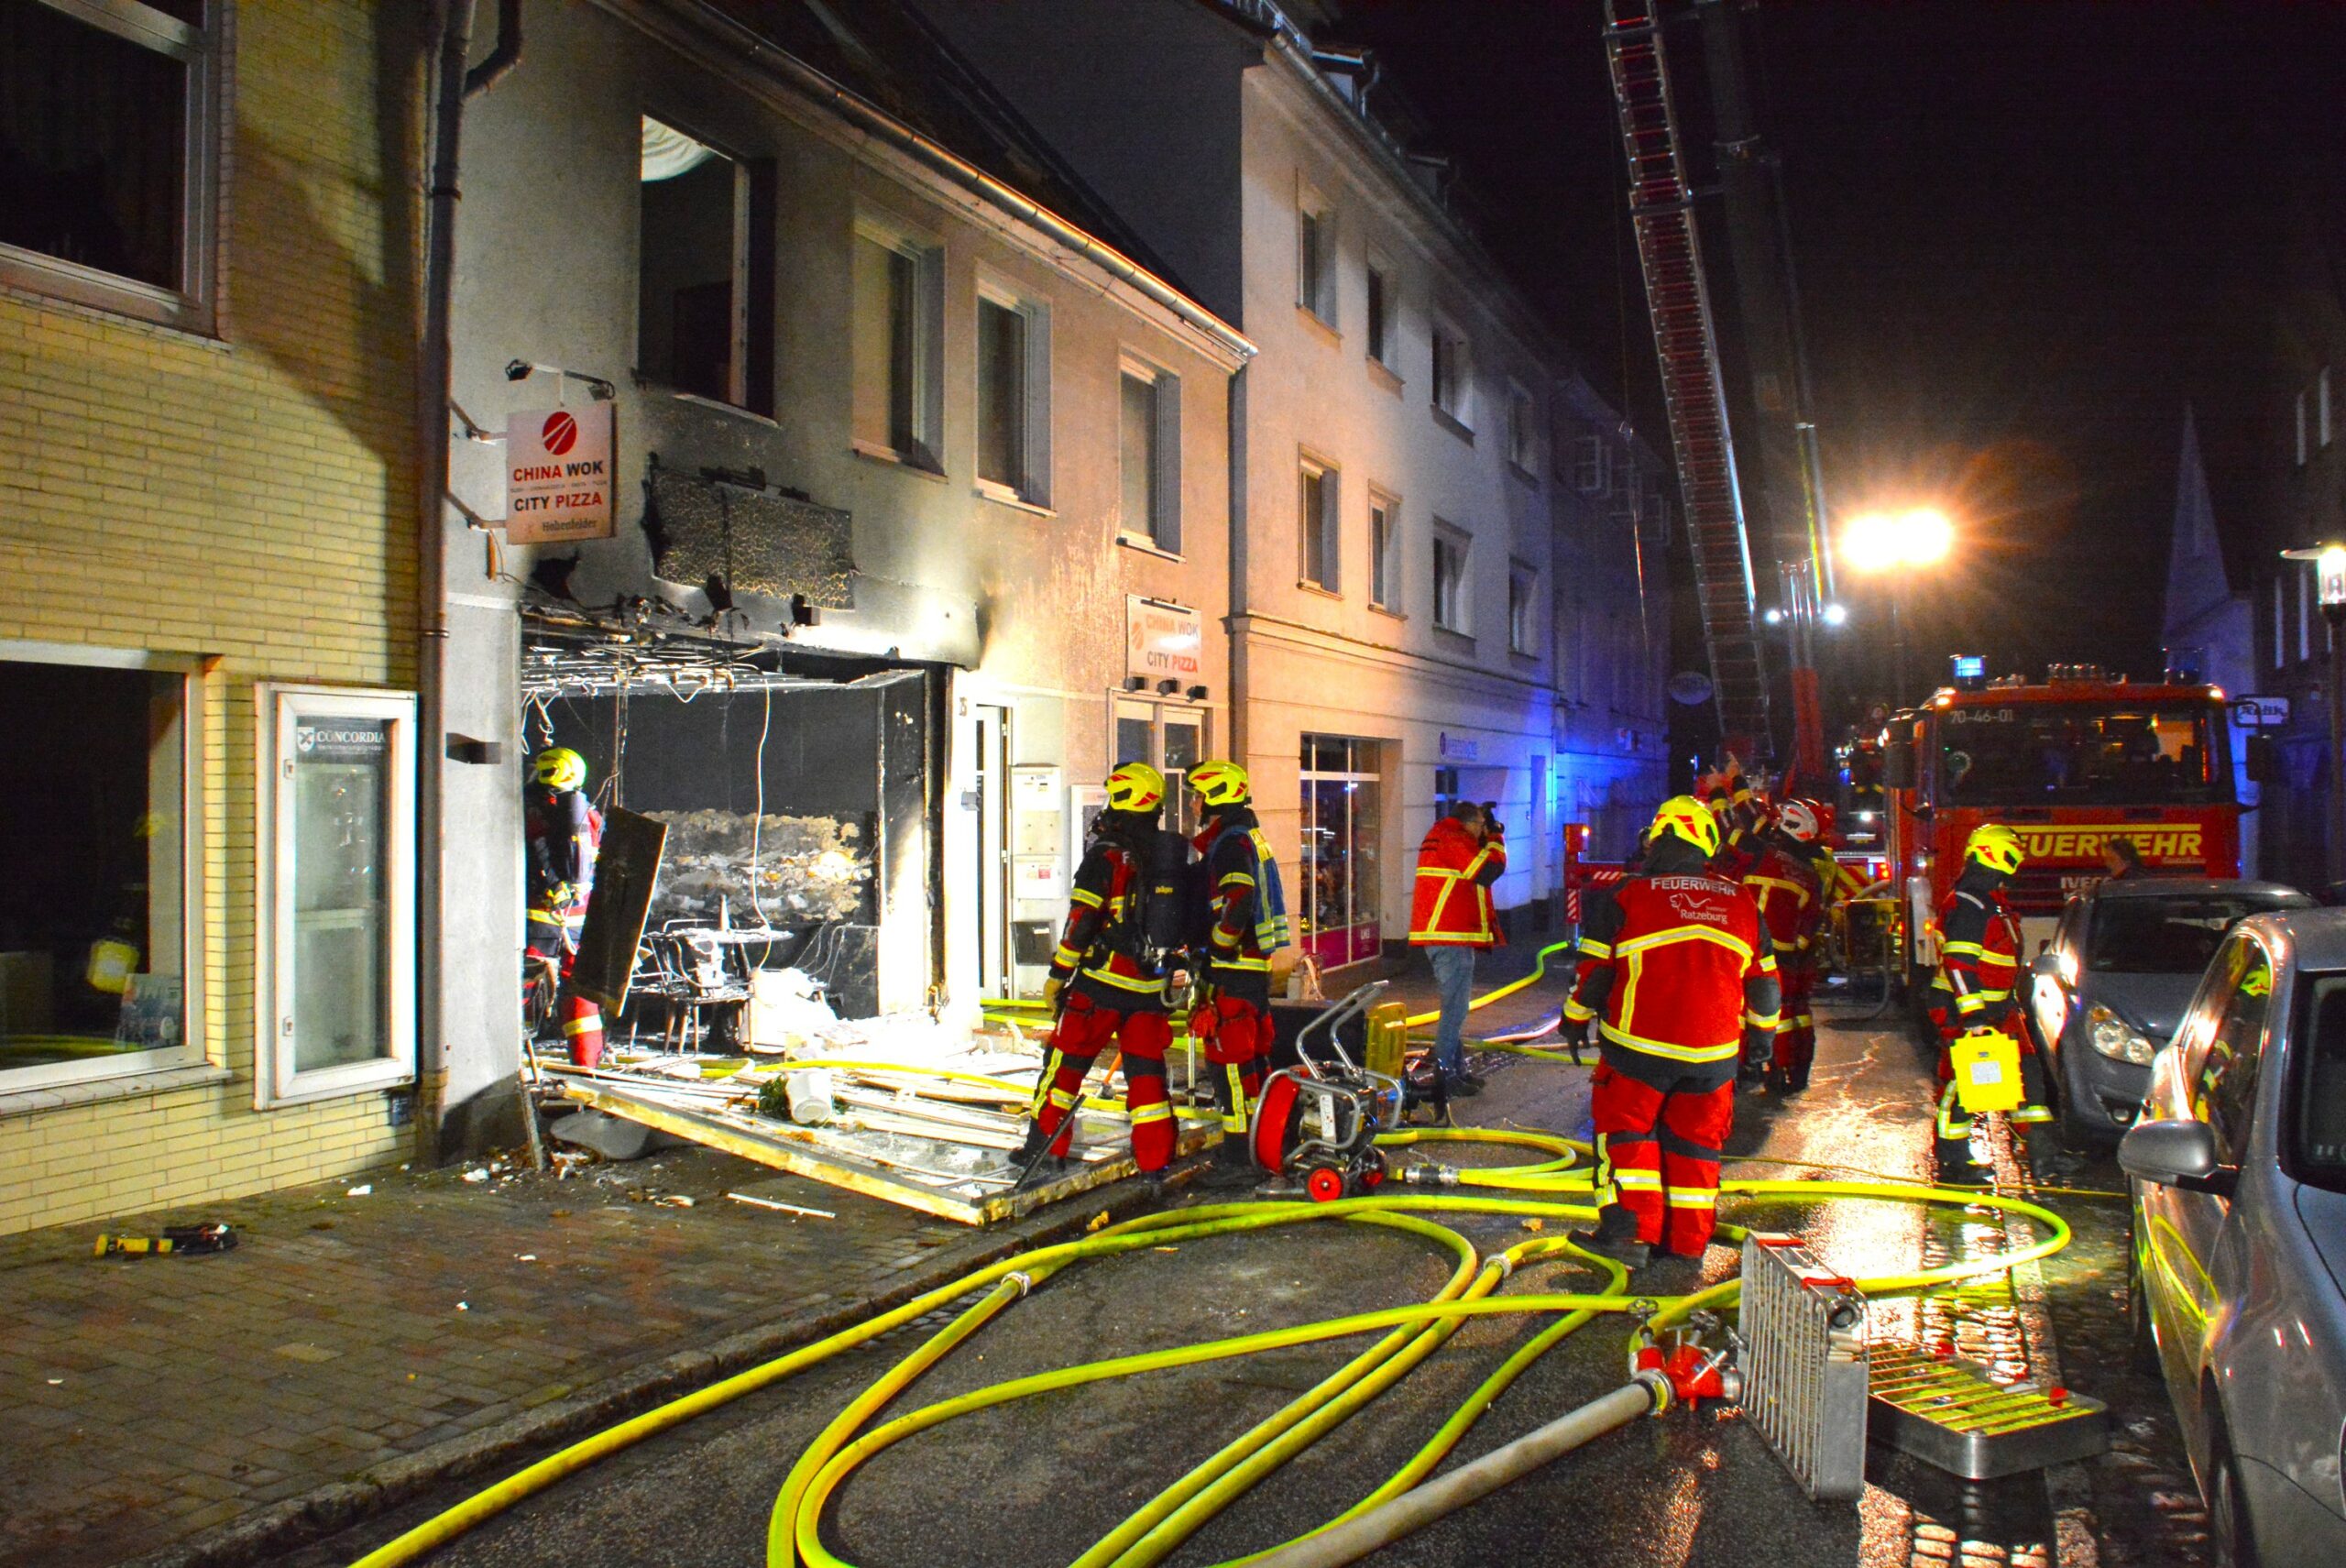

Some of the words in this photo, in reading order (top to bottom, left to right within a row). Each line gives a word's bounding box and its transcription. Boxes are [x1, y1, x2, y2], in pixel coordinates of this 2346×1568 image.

[513, 465, 562, 482] CHINA
[566, 460, 604, 477] WOK
[514, 496, 550, 511] CITY
[555, 491, 603, 509] PIZZA
[1146, 614, 1176, 634] CHINA
[1178, 620, 1199, 638] WOK
[1146, 651, 1169, 669] CITY
[1171, 654, 1198, 673] PIZZA
[1949, 708, 2013, 724] 70-46-01
[316, 730, 385, 743] CONCORDIA
[1650, 879, 1737, 896] FEUERWEHR
[1680, 909, 1728, 925] Ratzeburg
